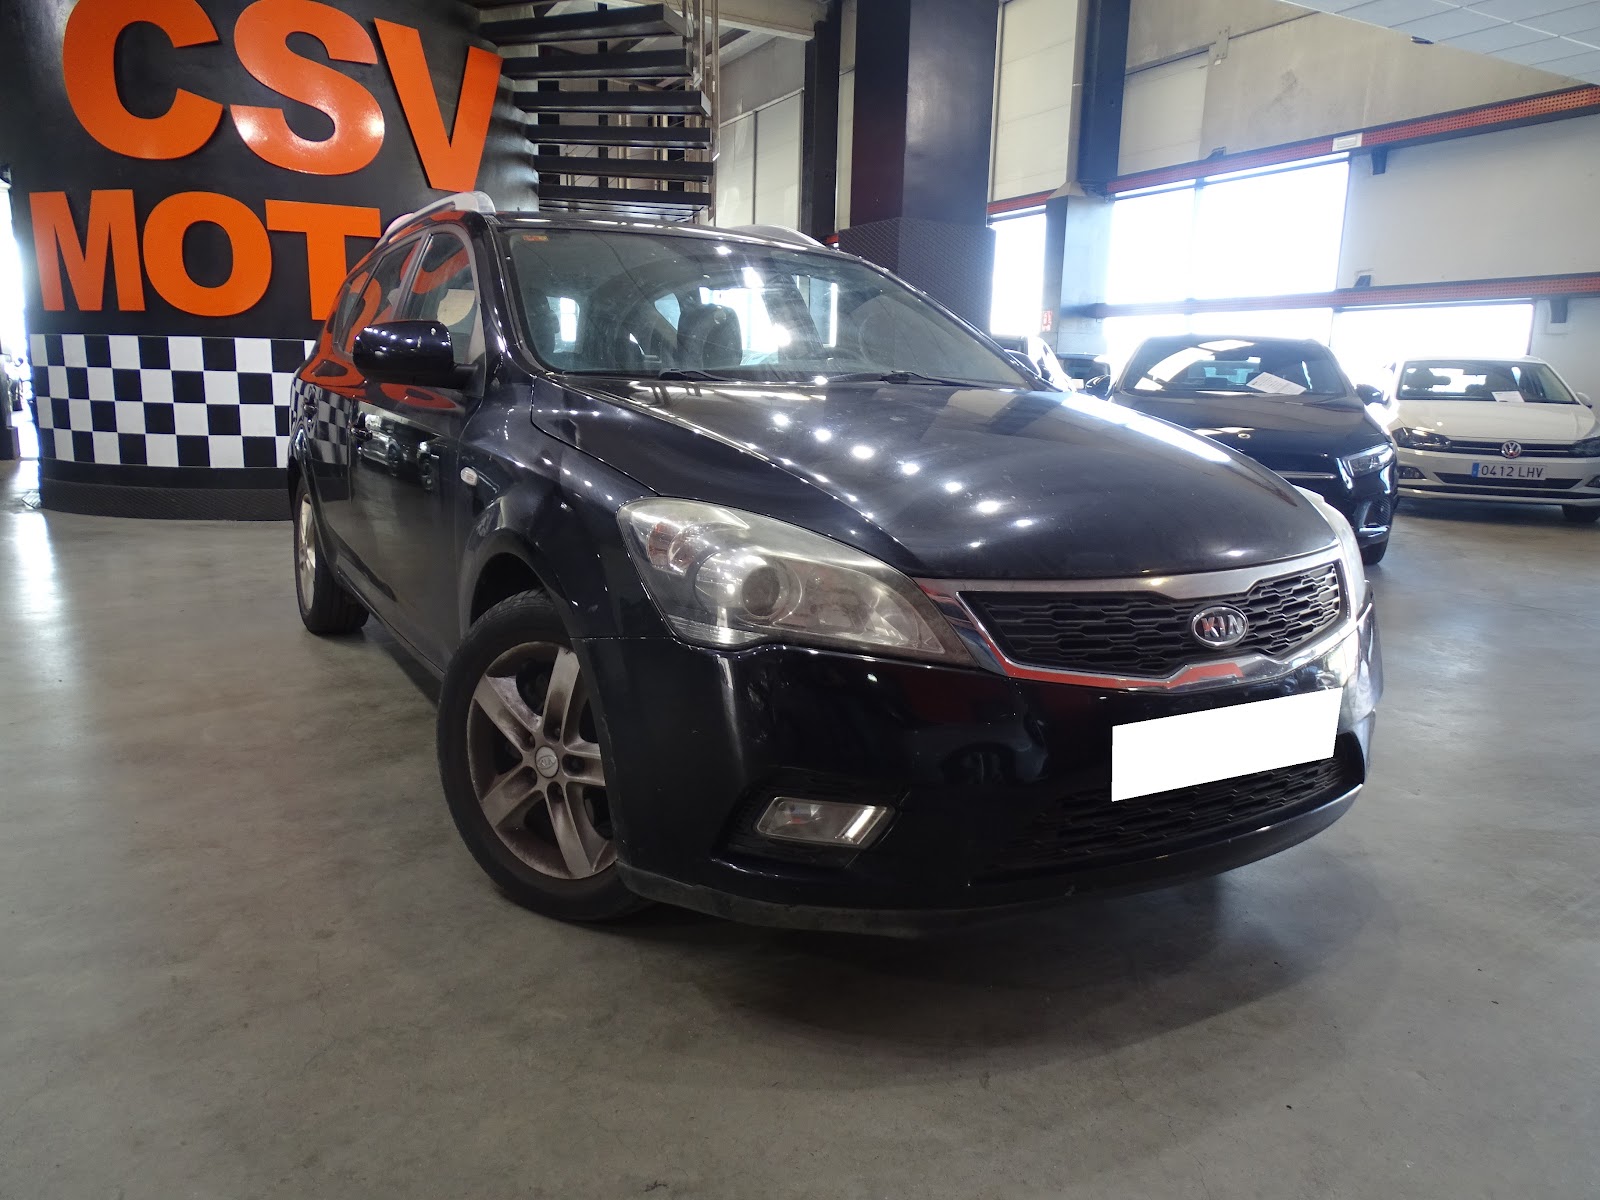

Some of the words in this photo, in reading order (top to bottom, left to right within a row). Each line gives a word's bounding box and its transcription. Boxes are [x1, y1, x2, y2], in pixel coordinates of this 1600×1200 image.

[63, 0, 503, 192] CSV
[29, 189, 413, 321] MOT
[1481, 465, 1513, 477] 0412
[1518, 467, 1543, 478] LHV
[1201, 615, 1244, 638] KIA
